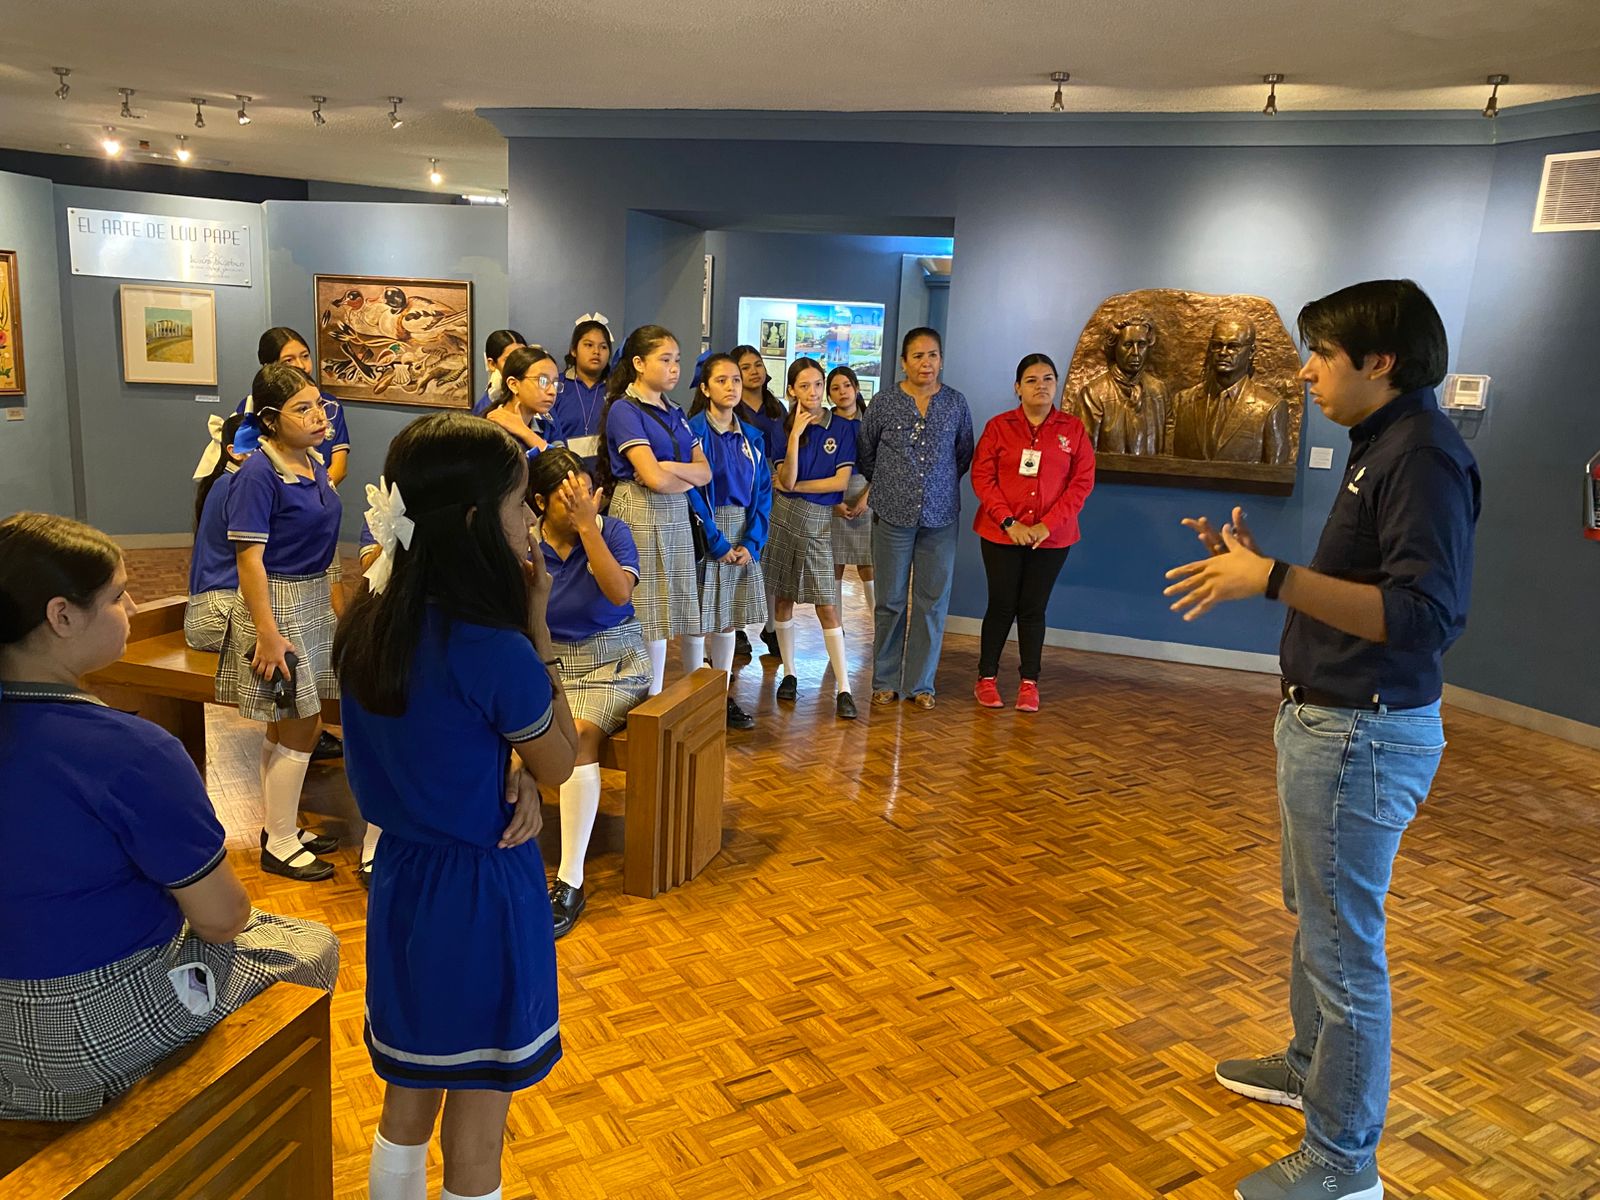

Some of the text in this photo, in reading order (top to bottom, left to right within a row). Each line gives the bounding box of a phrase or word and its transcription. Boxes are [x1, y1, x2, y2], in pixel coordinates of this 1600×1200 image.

[78, 216, 241, 246] EL ARTE DE LOU PAPE
